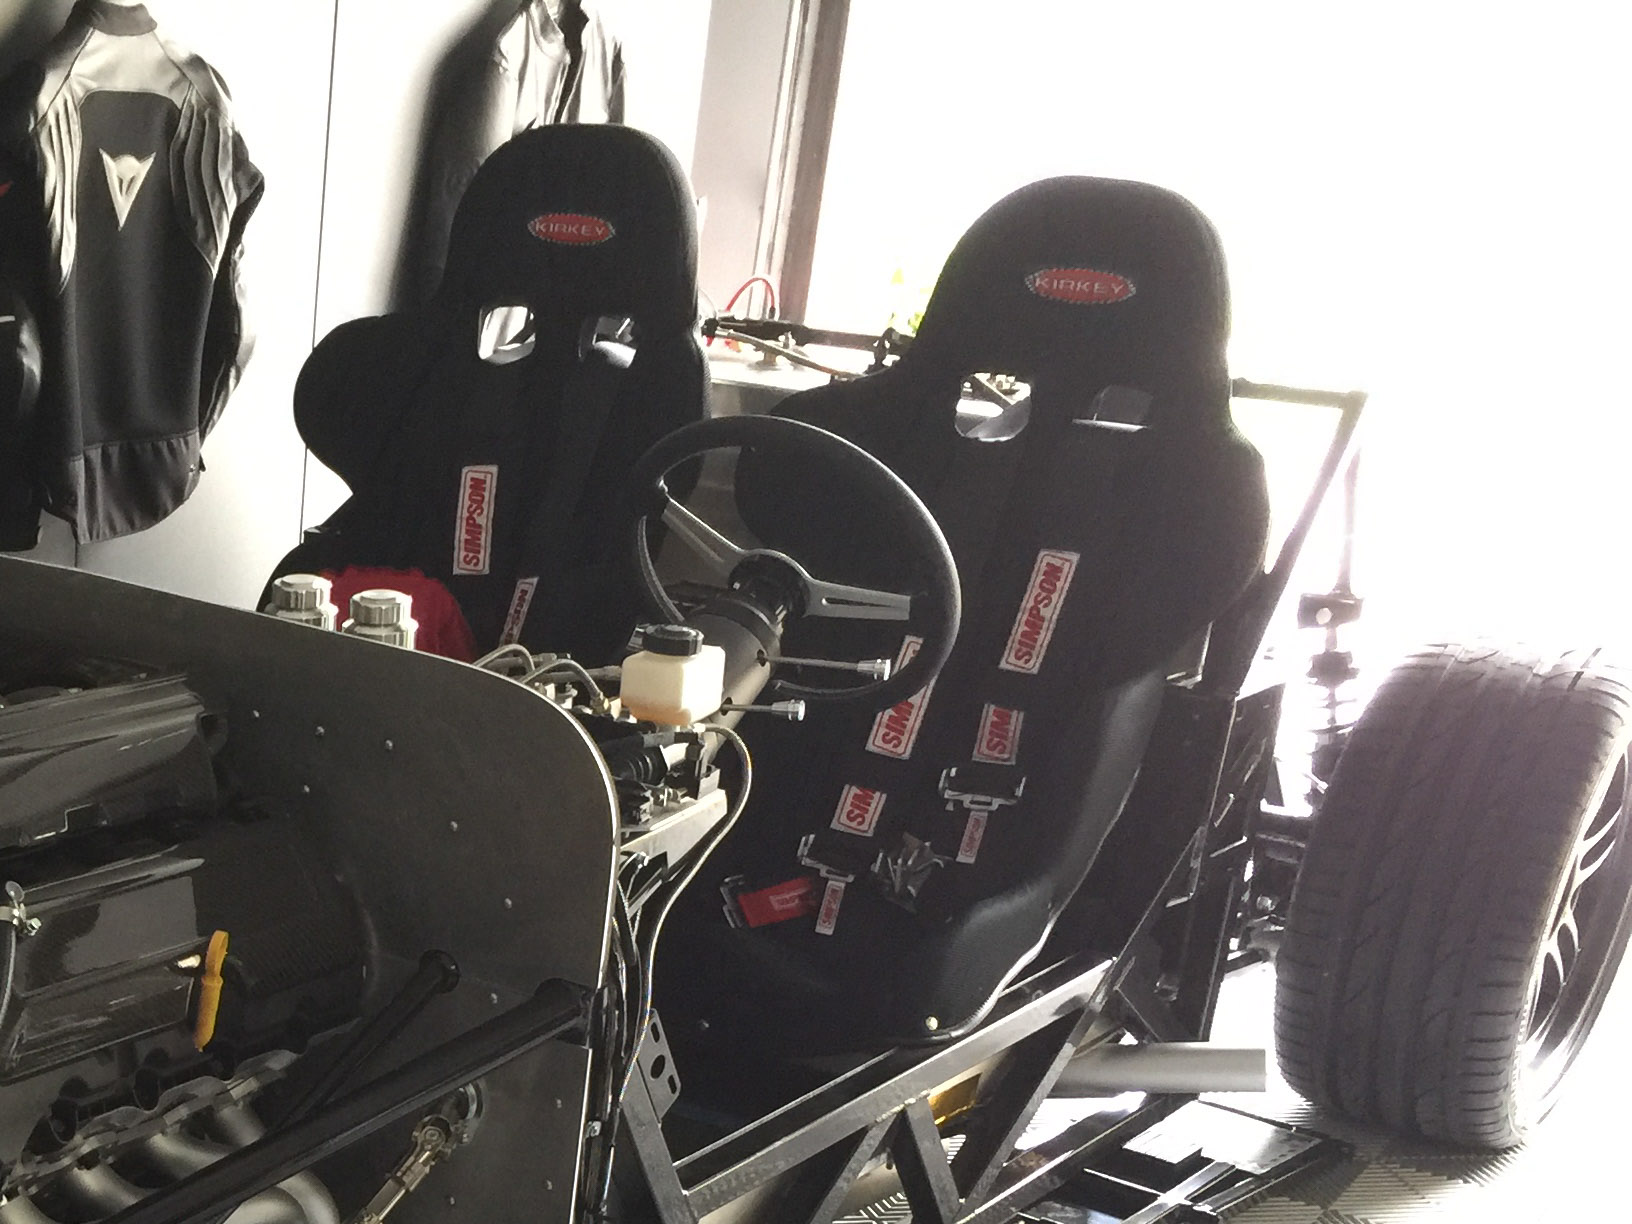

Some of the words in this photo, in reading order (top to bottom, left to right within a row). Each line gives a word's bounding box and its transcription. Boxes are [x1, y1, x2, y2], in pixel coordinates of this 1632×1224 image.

[536, 222, 604, 236] KIRKEY
[1035, 277, 1124, 294] KIRKEY
[463, 477, 487, 567] SIMPSON
[1014, 561, 1063, 664] SIMPSON
